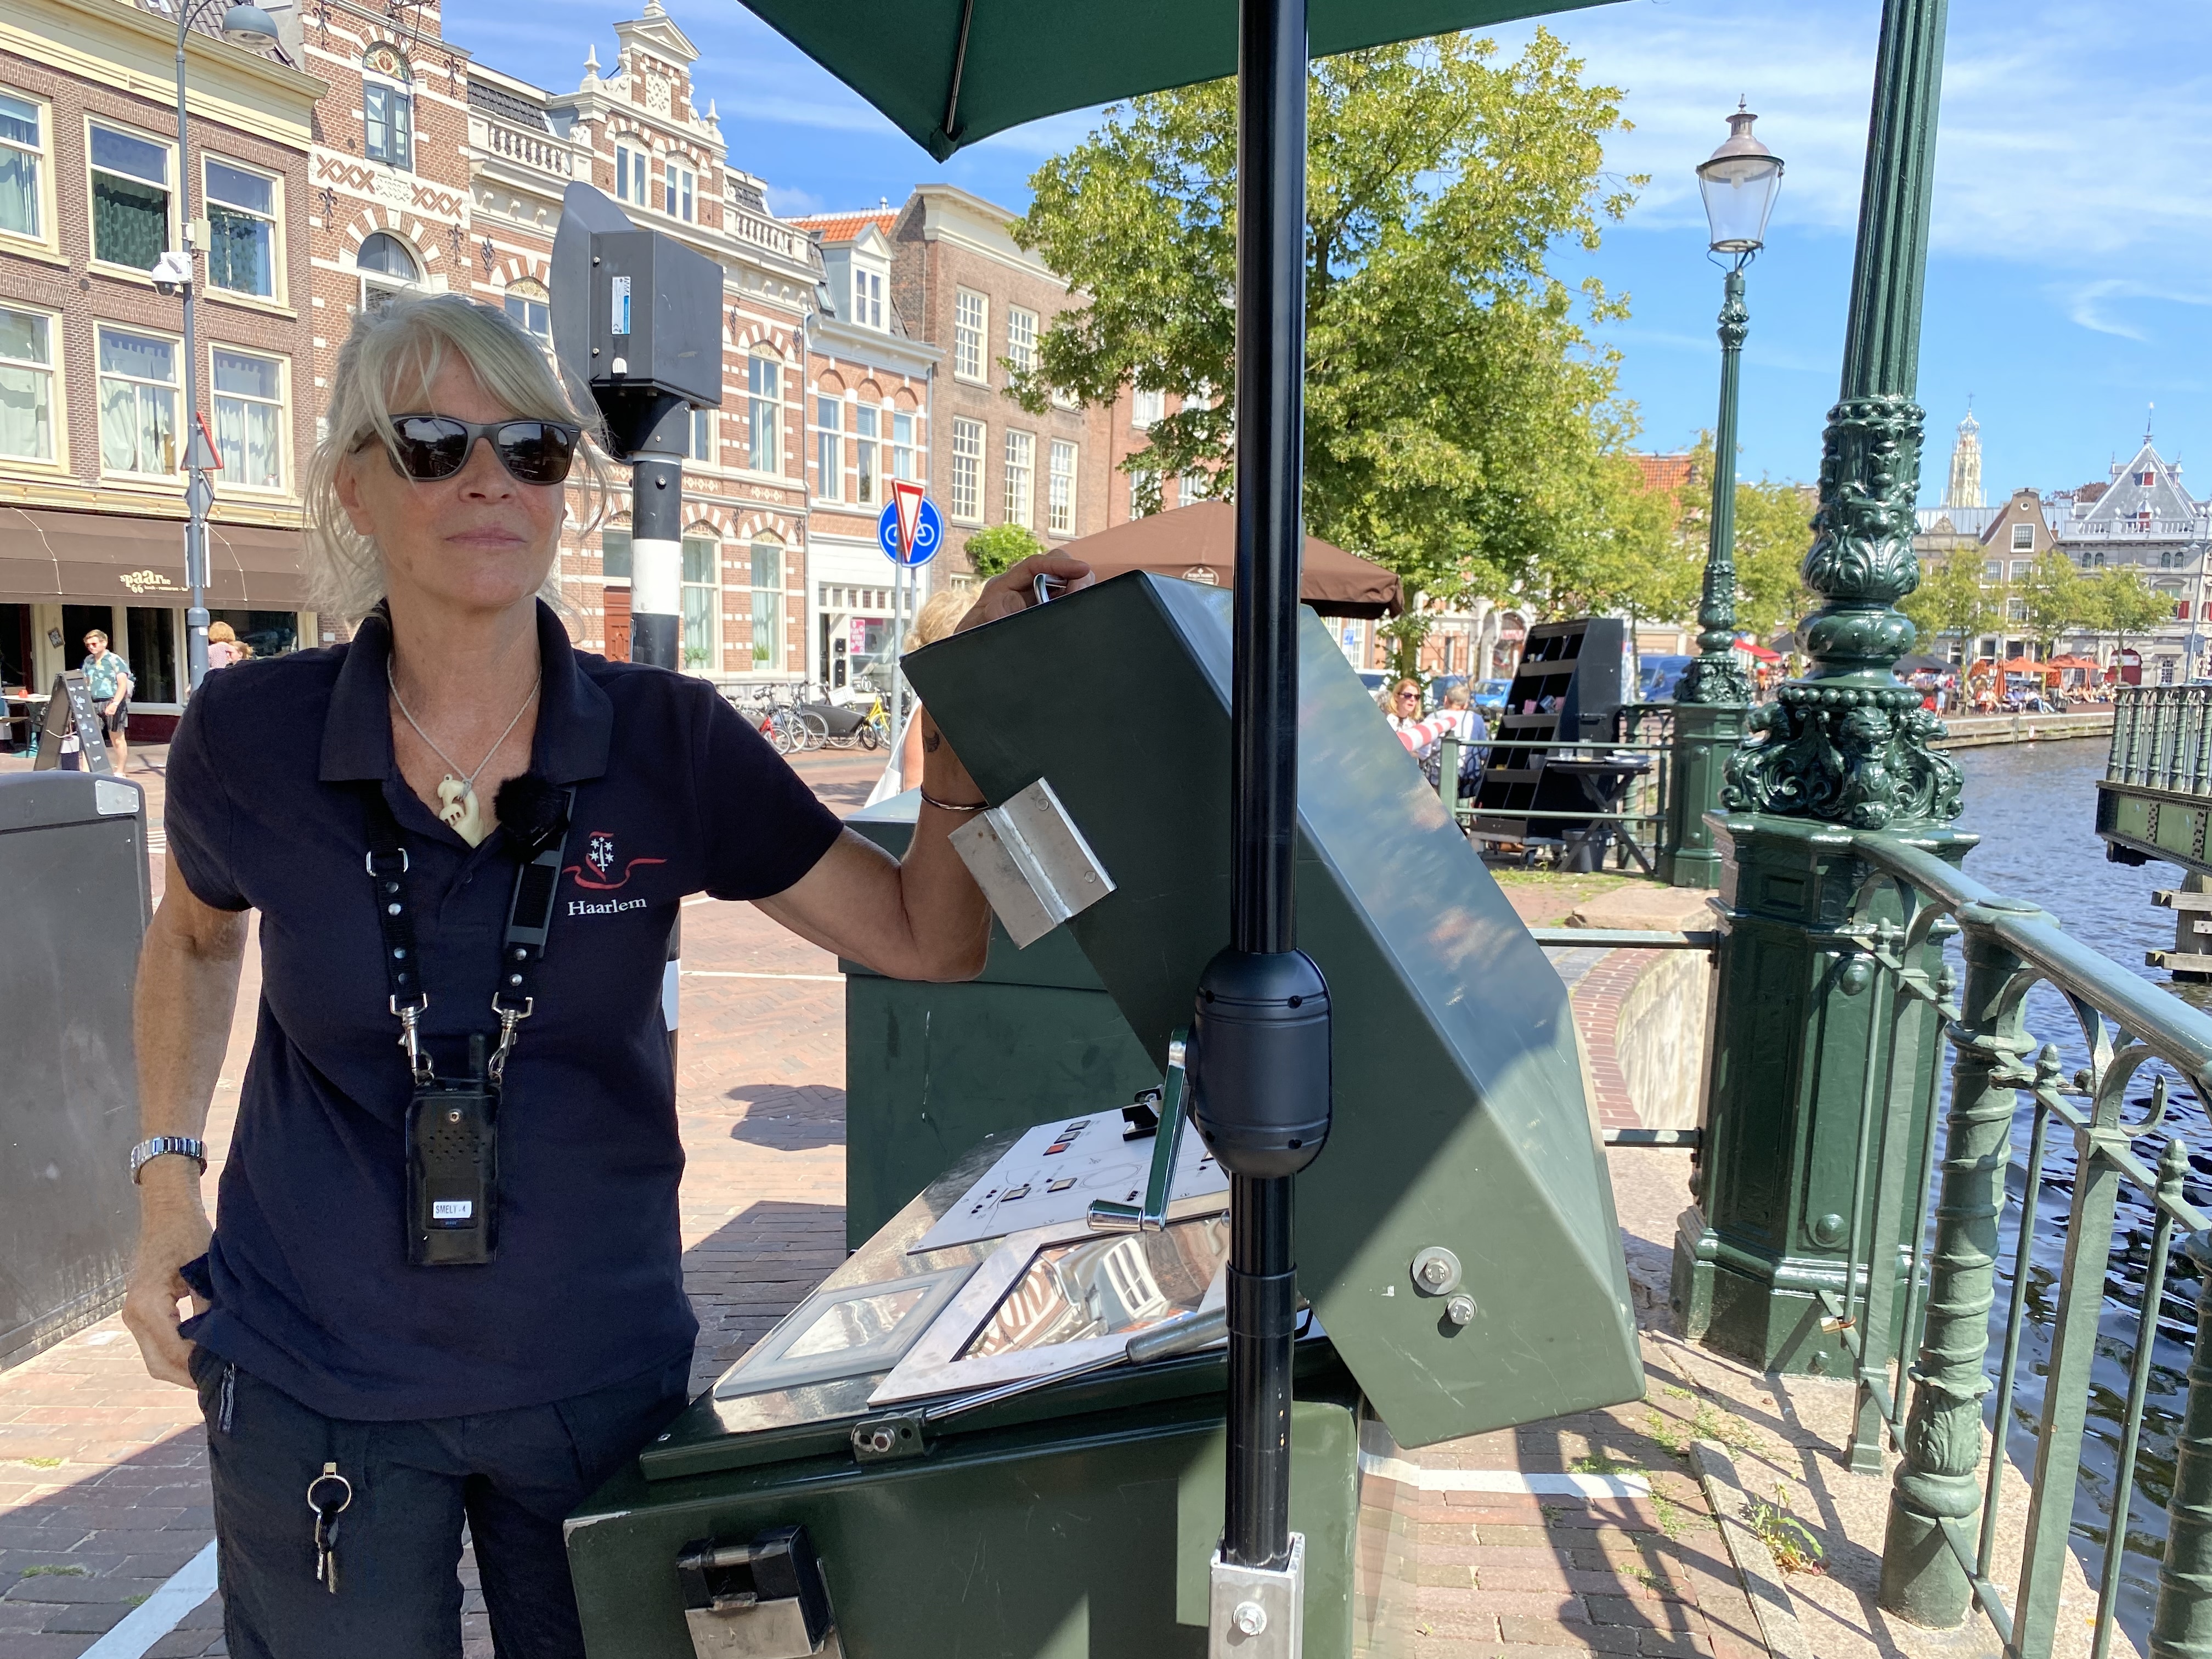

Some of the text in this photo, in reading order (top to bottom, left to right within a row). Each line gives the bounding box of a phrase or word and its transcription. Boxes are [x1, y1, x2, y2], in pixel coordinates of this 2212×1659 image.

[119, 569, 171, 588] spaarne
[131, 584, 144, 593] 66
[567, 898, 647, 916] Haarlem
